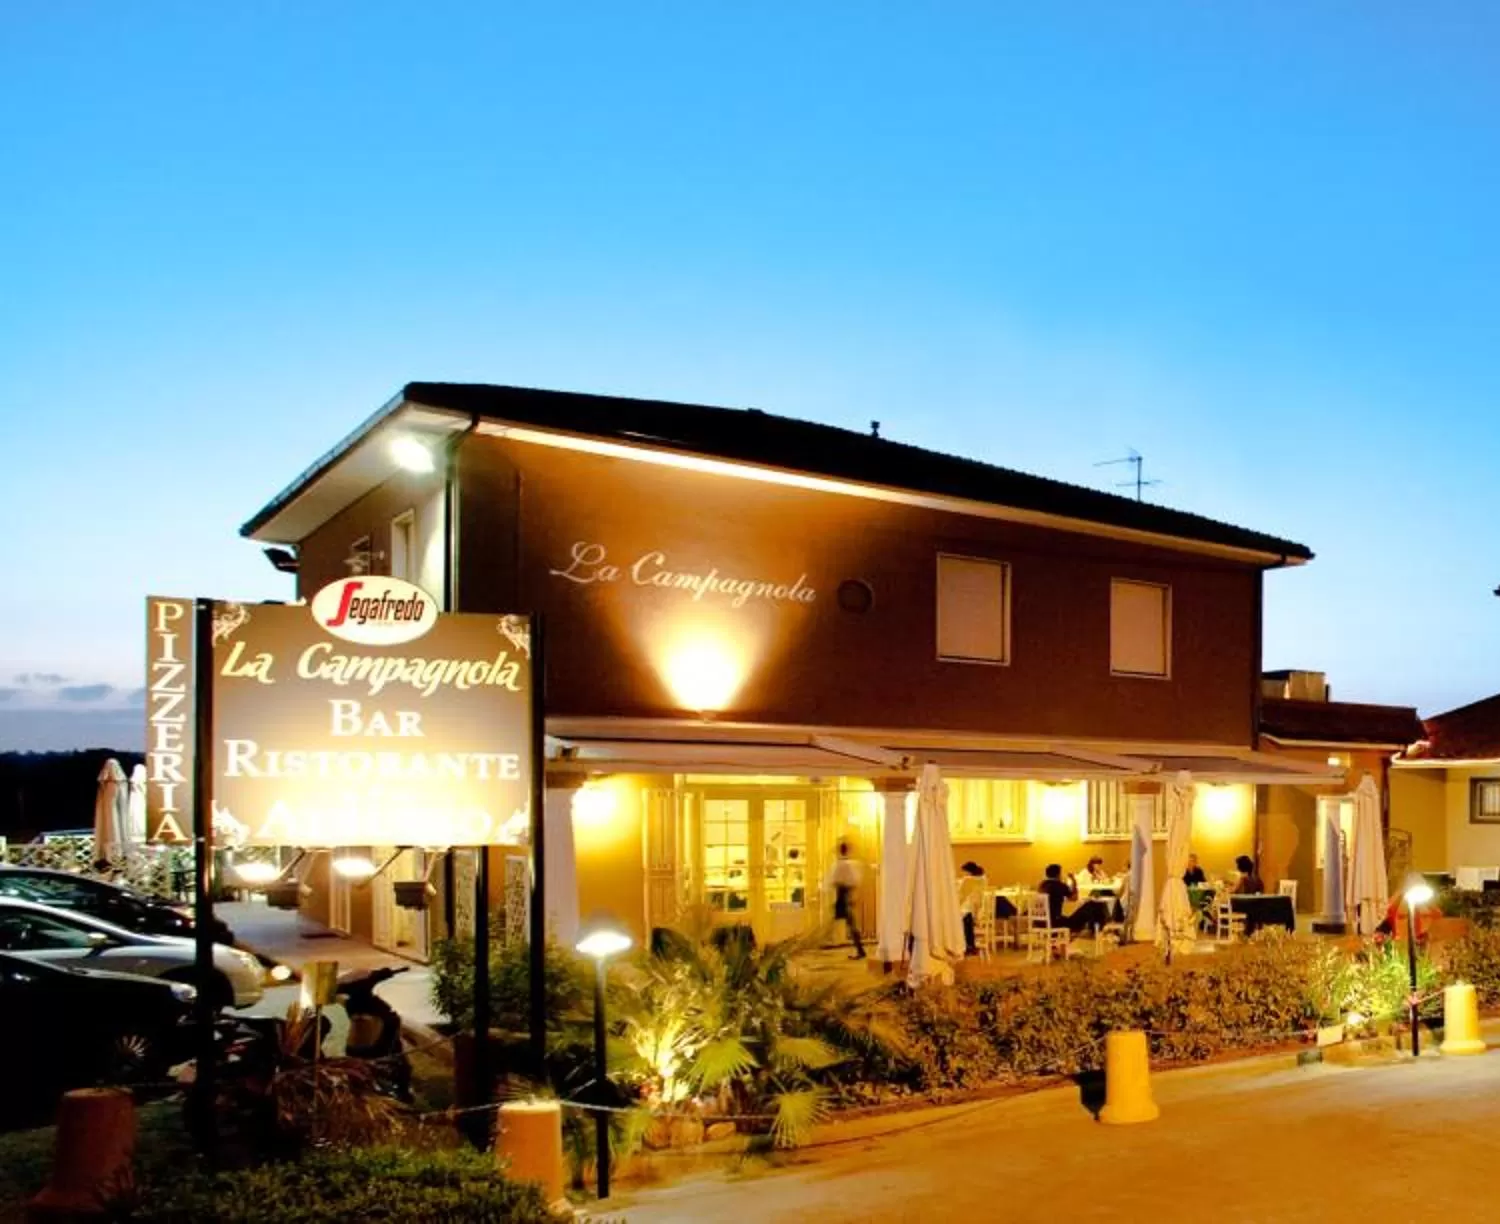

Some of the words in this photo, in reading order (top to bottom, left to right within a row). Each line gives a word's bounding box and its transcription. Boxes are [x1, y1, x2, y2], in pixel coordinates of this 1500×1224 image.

[326, 582, 425, 627] Segafredo
[549, 541, 621, 584] La
[631, 551, 817, 608] Campagnola
[220, 641, 276, 685] La
[296, 642, 523, 697] Campagnola
[150, 602, 188, 842] PIZZERIA
